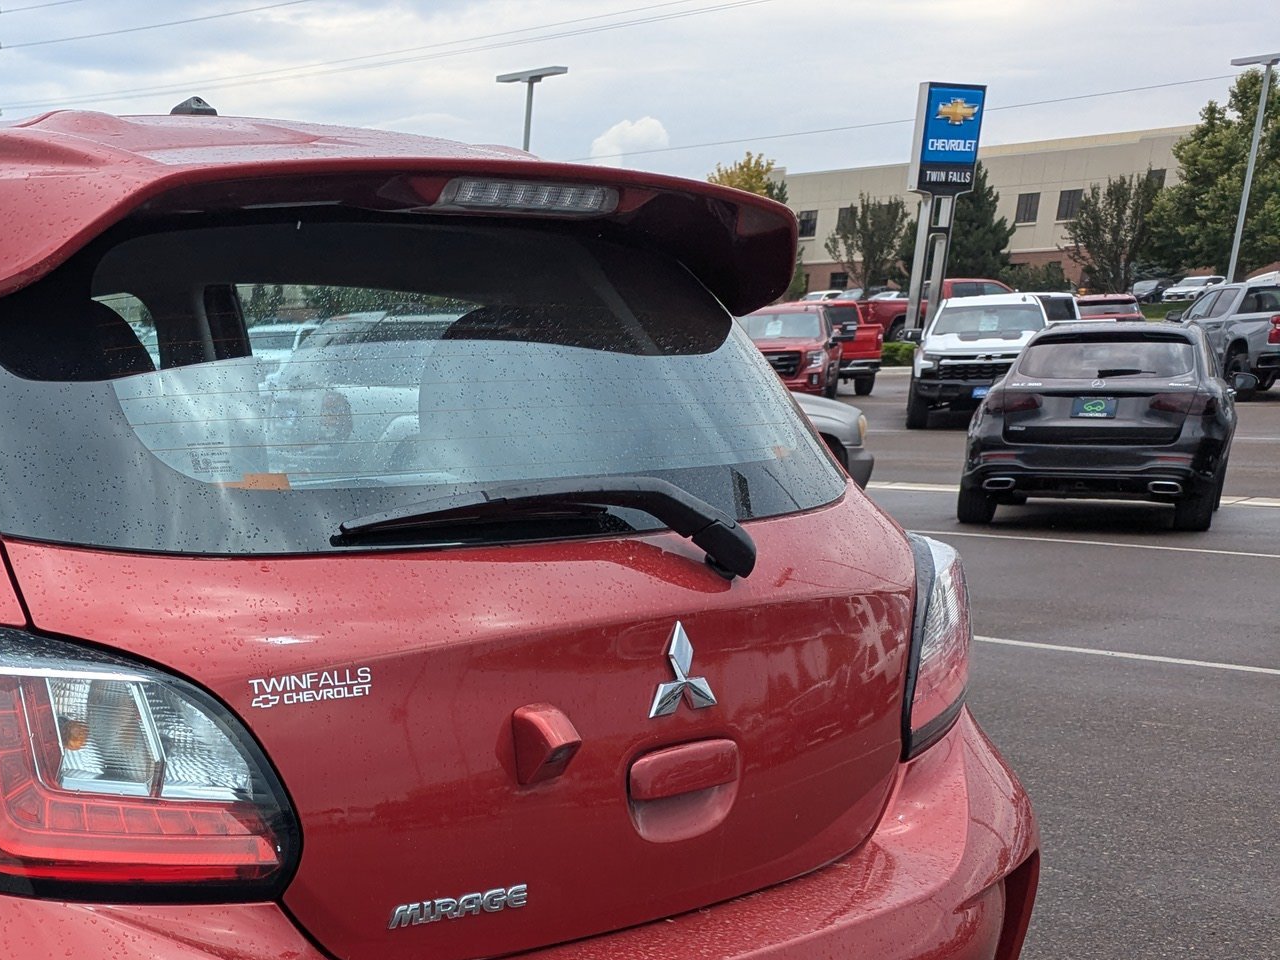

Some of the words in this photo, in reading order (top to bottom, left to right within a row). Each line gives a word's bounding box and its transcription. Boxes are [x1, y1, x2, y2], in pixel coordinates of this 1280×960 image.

[928, 139, 976, 151] CHEVROLET
[926, 171, 946, 182] TWIN
[948, 172, 971, 182] FALLS
[248, 667, 372, 694] TWINFALLS
[283, 684, 372, 704] CHEVROLET
[388, 884, 528, 929] MIRAGE
